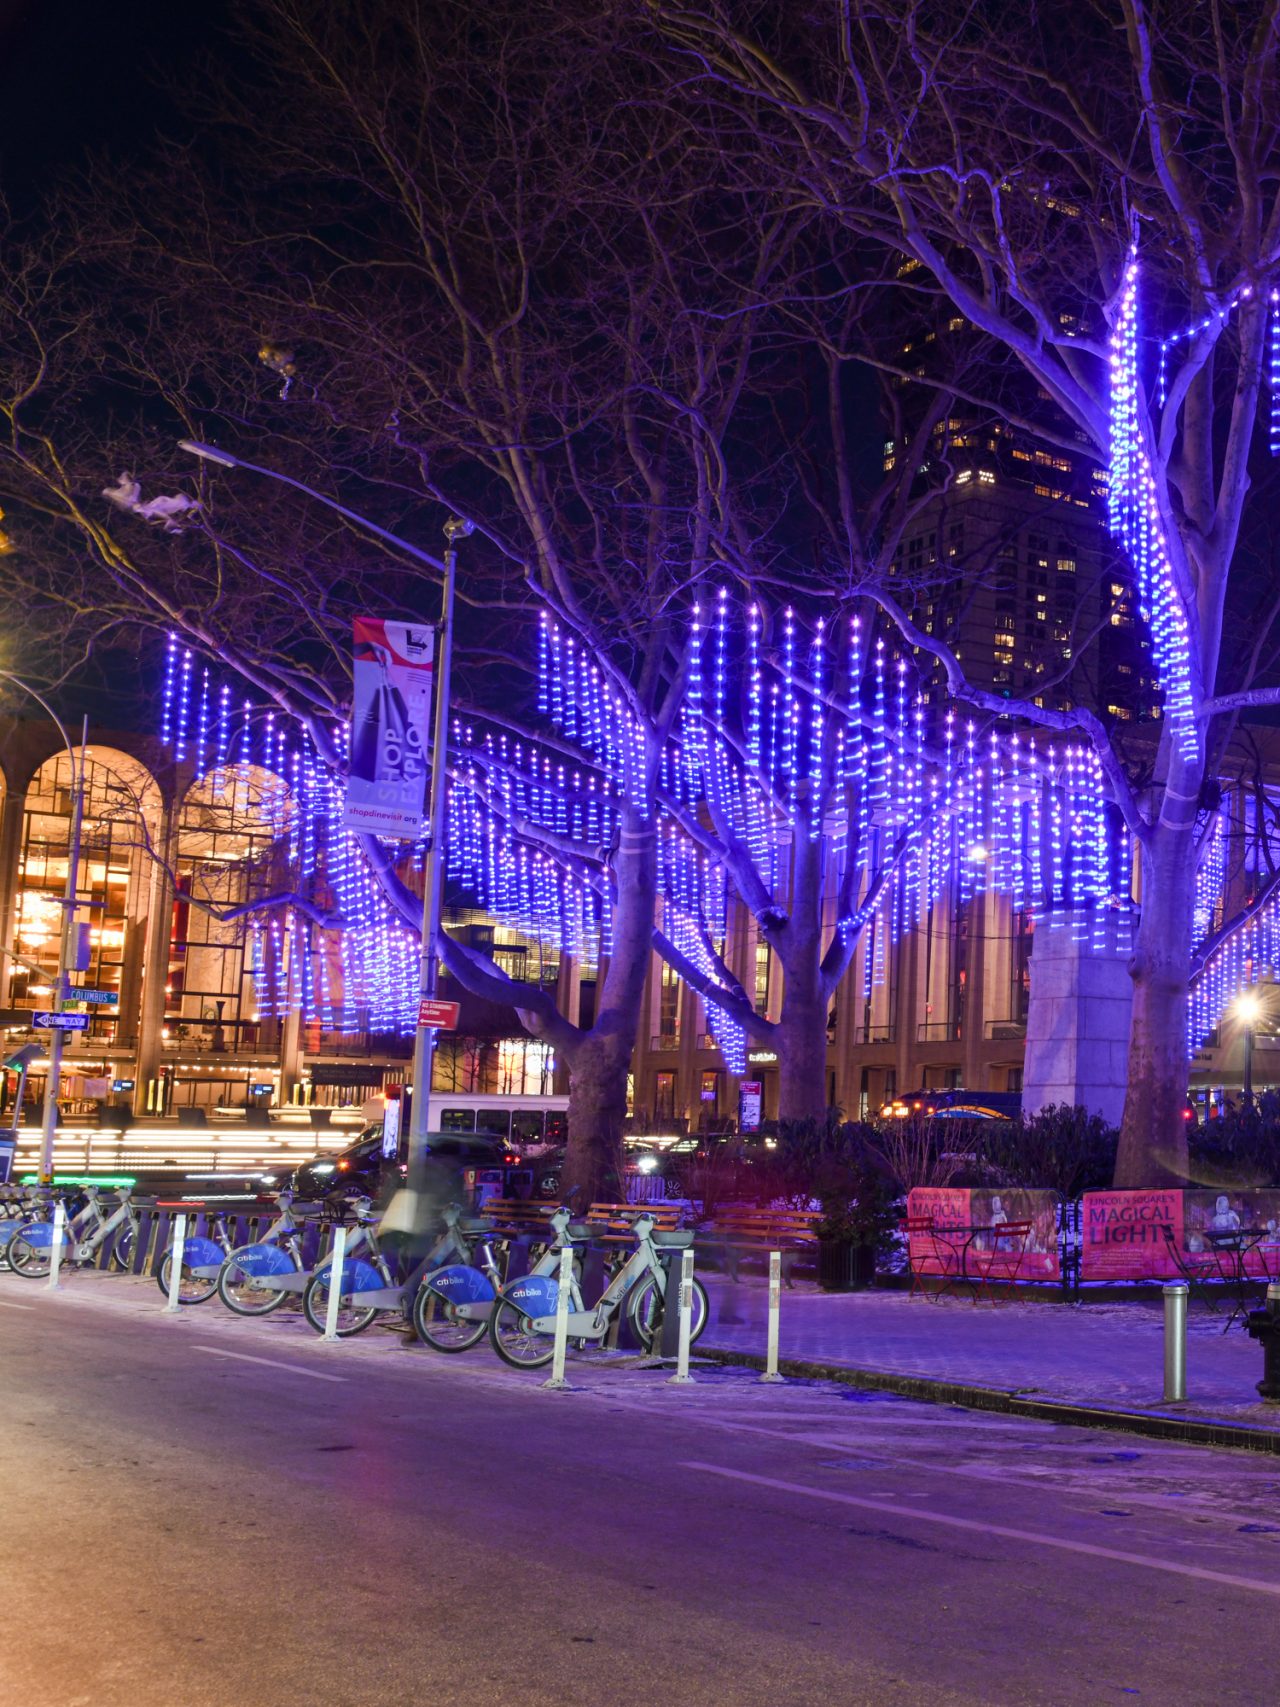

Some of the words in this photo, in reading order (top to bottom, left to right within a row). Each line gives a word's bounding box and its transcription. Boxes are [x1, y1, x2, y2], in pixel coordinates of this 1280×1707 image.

[380, 728, 403, 802] SHOP
[71, 990, 109, 1003] COLUMBUS
[42, 1016, 60, 1024] ONE
[65, 1018, 82, 1026] WAY
[1089, 1197, 1130, 1206] LINCOLN
[912, 1203, 965, 1219] MAGICAL
[1089, 1206, 1175, 1223] MAGICAL
[436, 1277, 449, 1286] citi
[450, 1276, 464, 1285] bike
[512, 1287, 526, 1298] citi
[526, 1288, 542, 1297] bike
